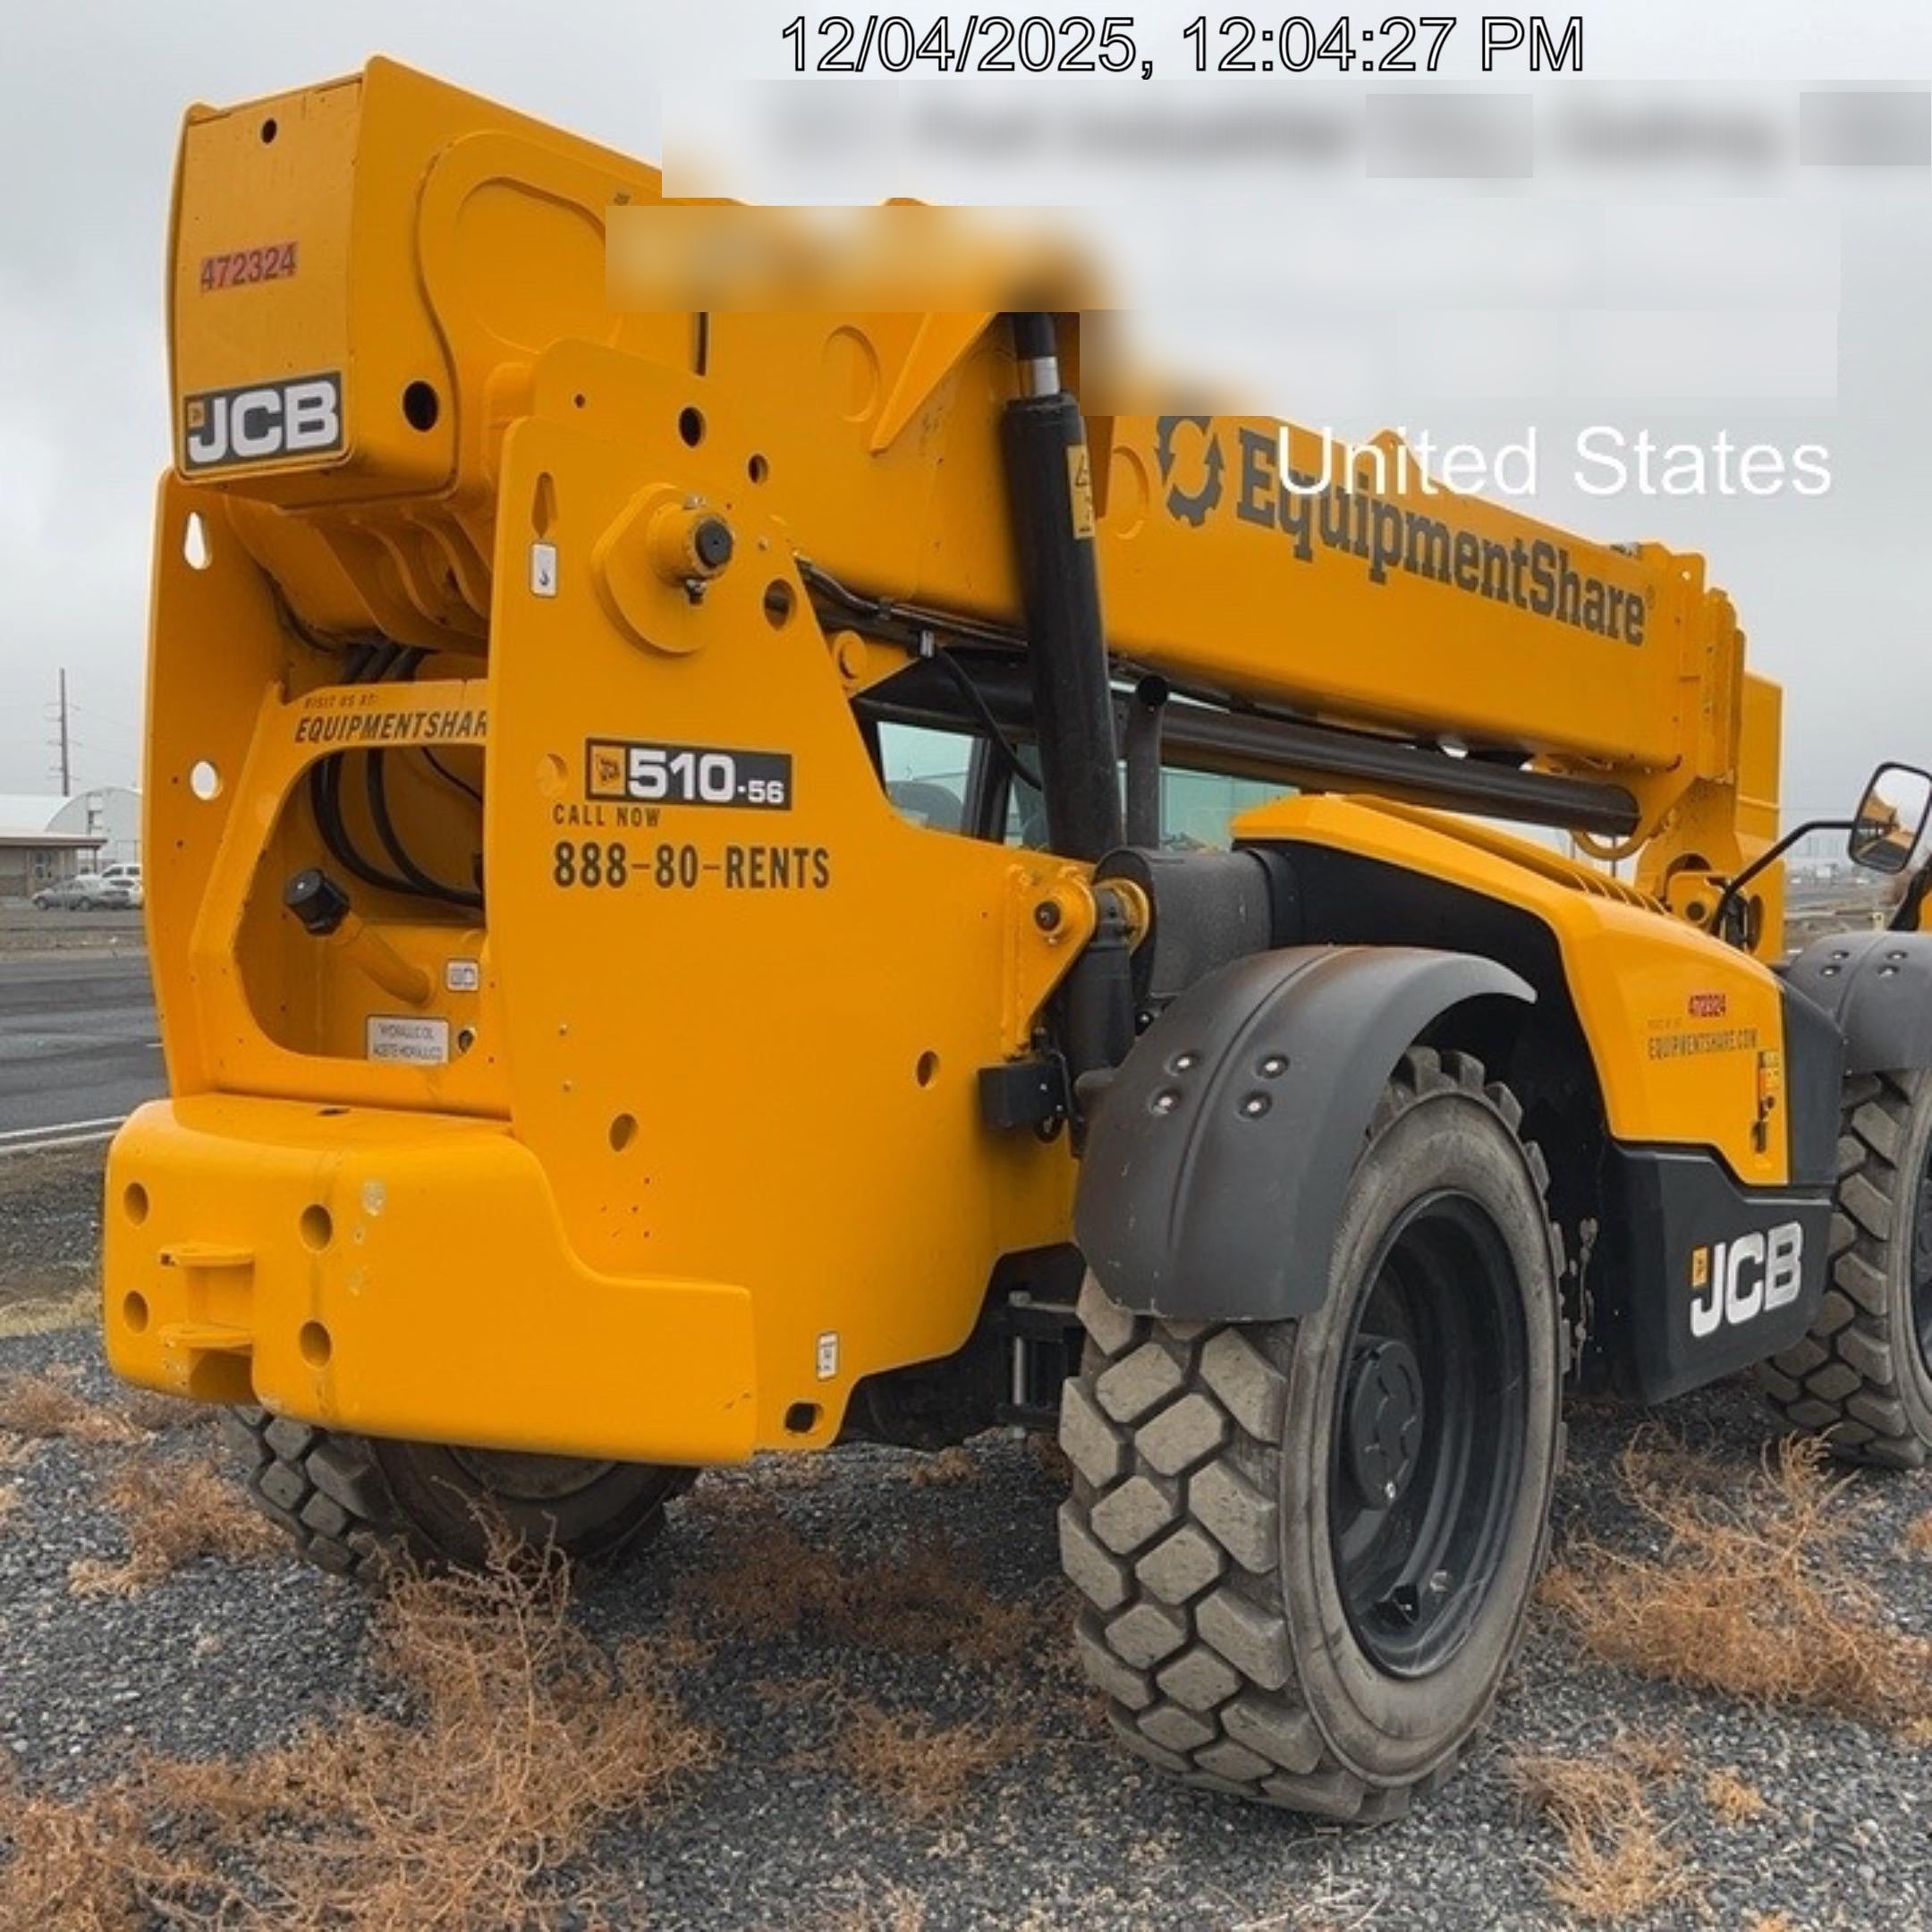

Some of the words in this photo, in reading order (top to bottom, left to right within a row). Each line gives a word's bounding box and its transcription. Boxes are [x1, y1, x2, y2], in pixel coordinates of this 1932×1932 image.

[199, 242, 299, 291] 472324
[188, 380, 339, 463] JCB
[552, 804, 606, 826] CALL
[617, 808, 660, 827] NOW
[555, 841, 830, 889] 888-80-RENTS
[1690, 1221, 1803, 1337] JCB
